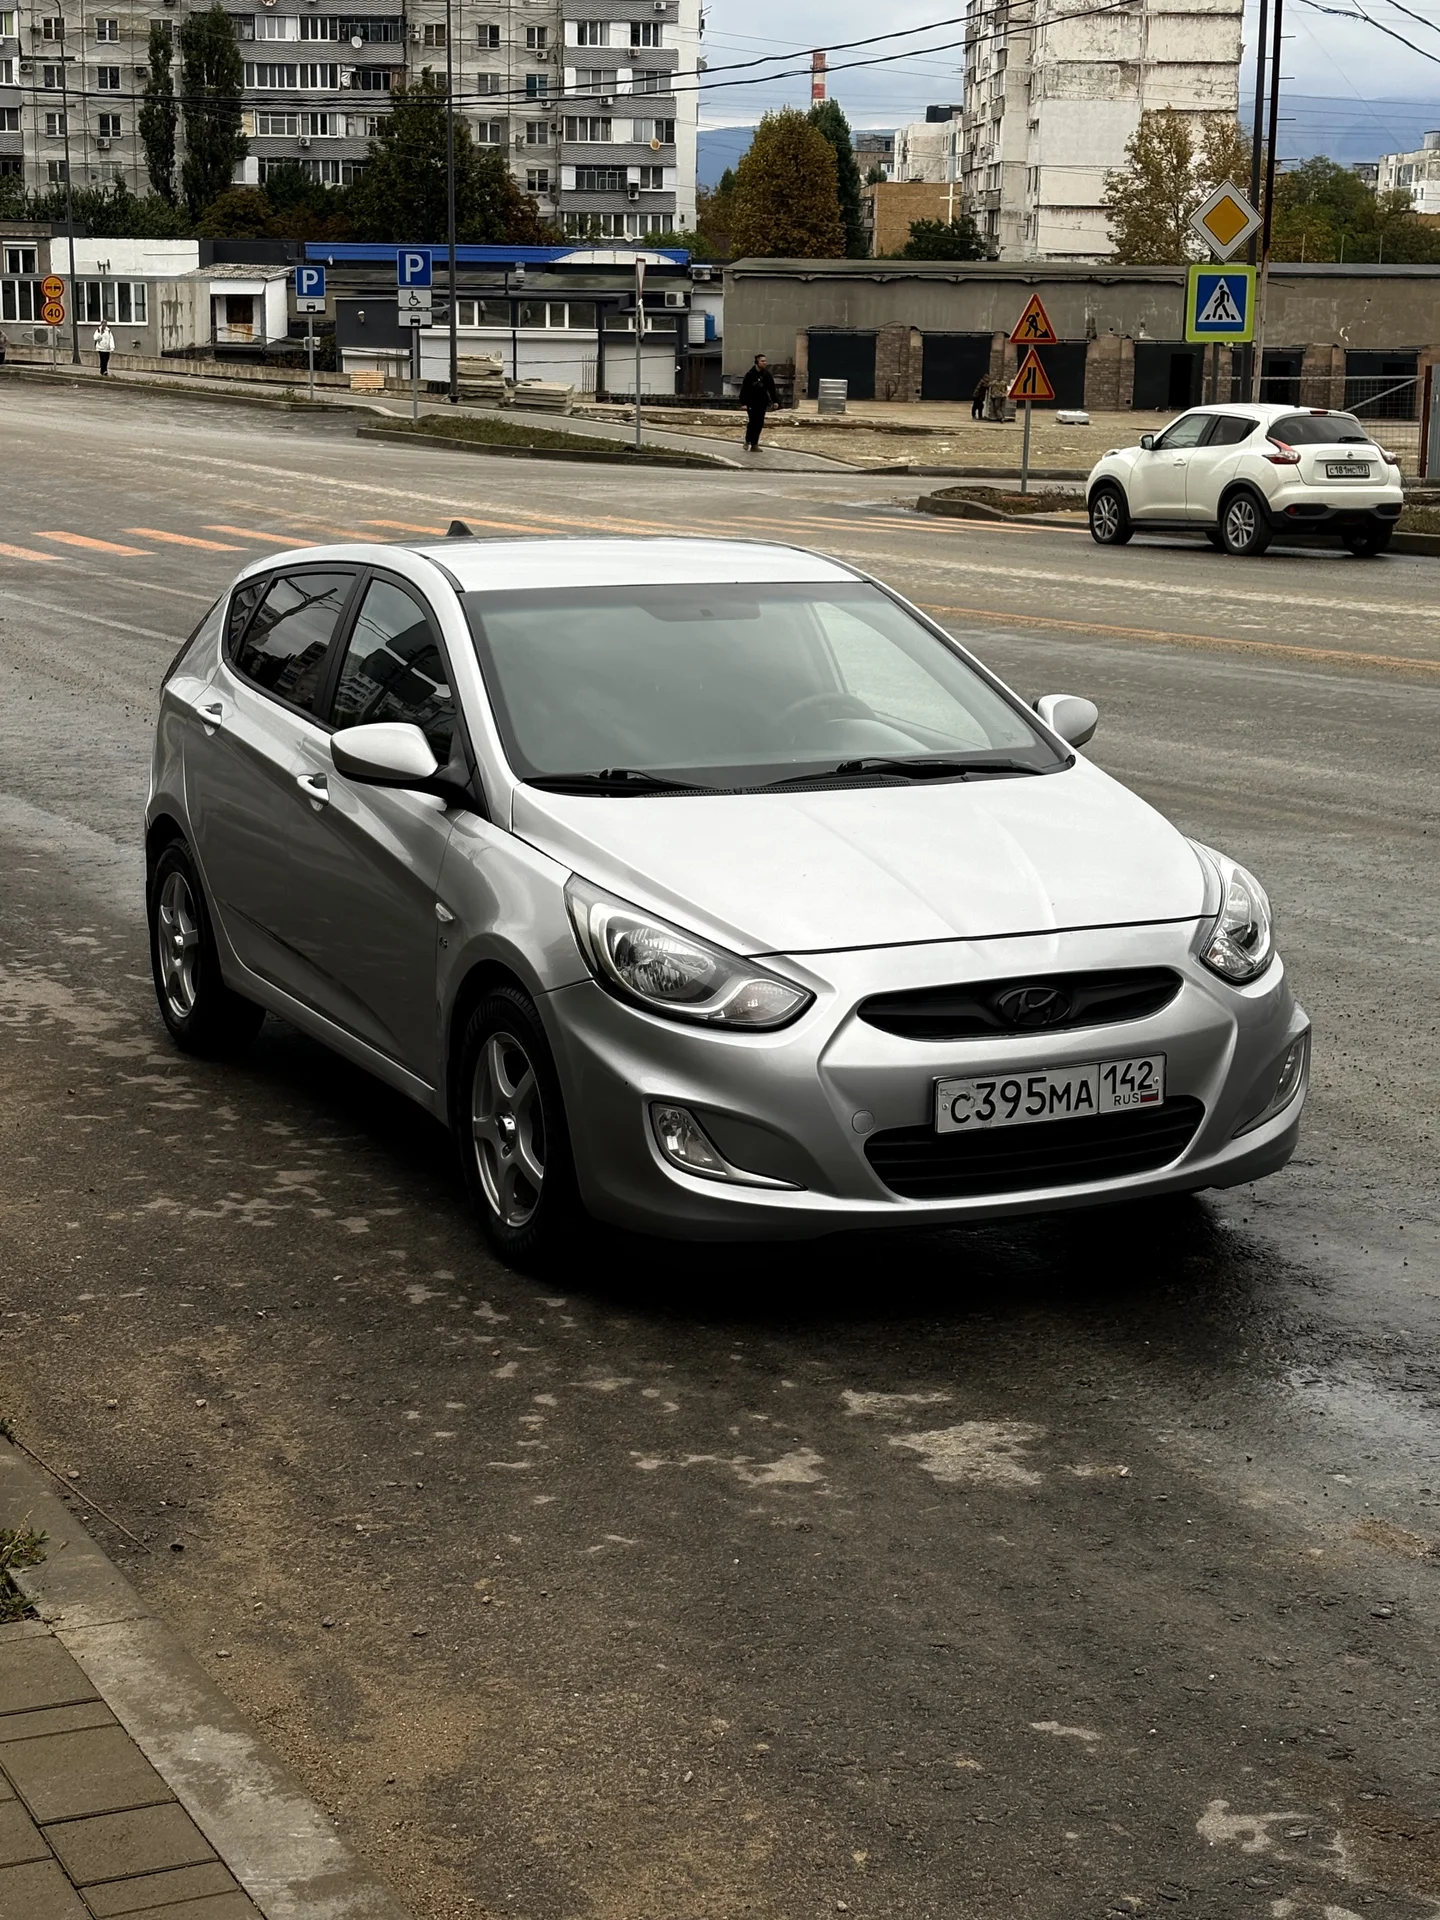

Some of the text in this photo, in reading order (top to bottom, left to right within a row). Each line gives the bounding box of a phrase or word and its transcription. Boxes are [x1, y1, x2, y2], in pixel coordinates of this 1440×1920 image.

[405, 254, 424, 282] P
[302, 269, 319, 294] P
[47, 308, 61, 318] 40
[950, 1060, 1154, 1124] С395МА 142
[1114, 1093, 1140, 1106] RUS
